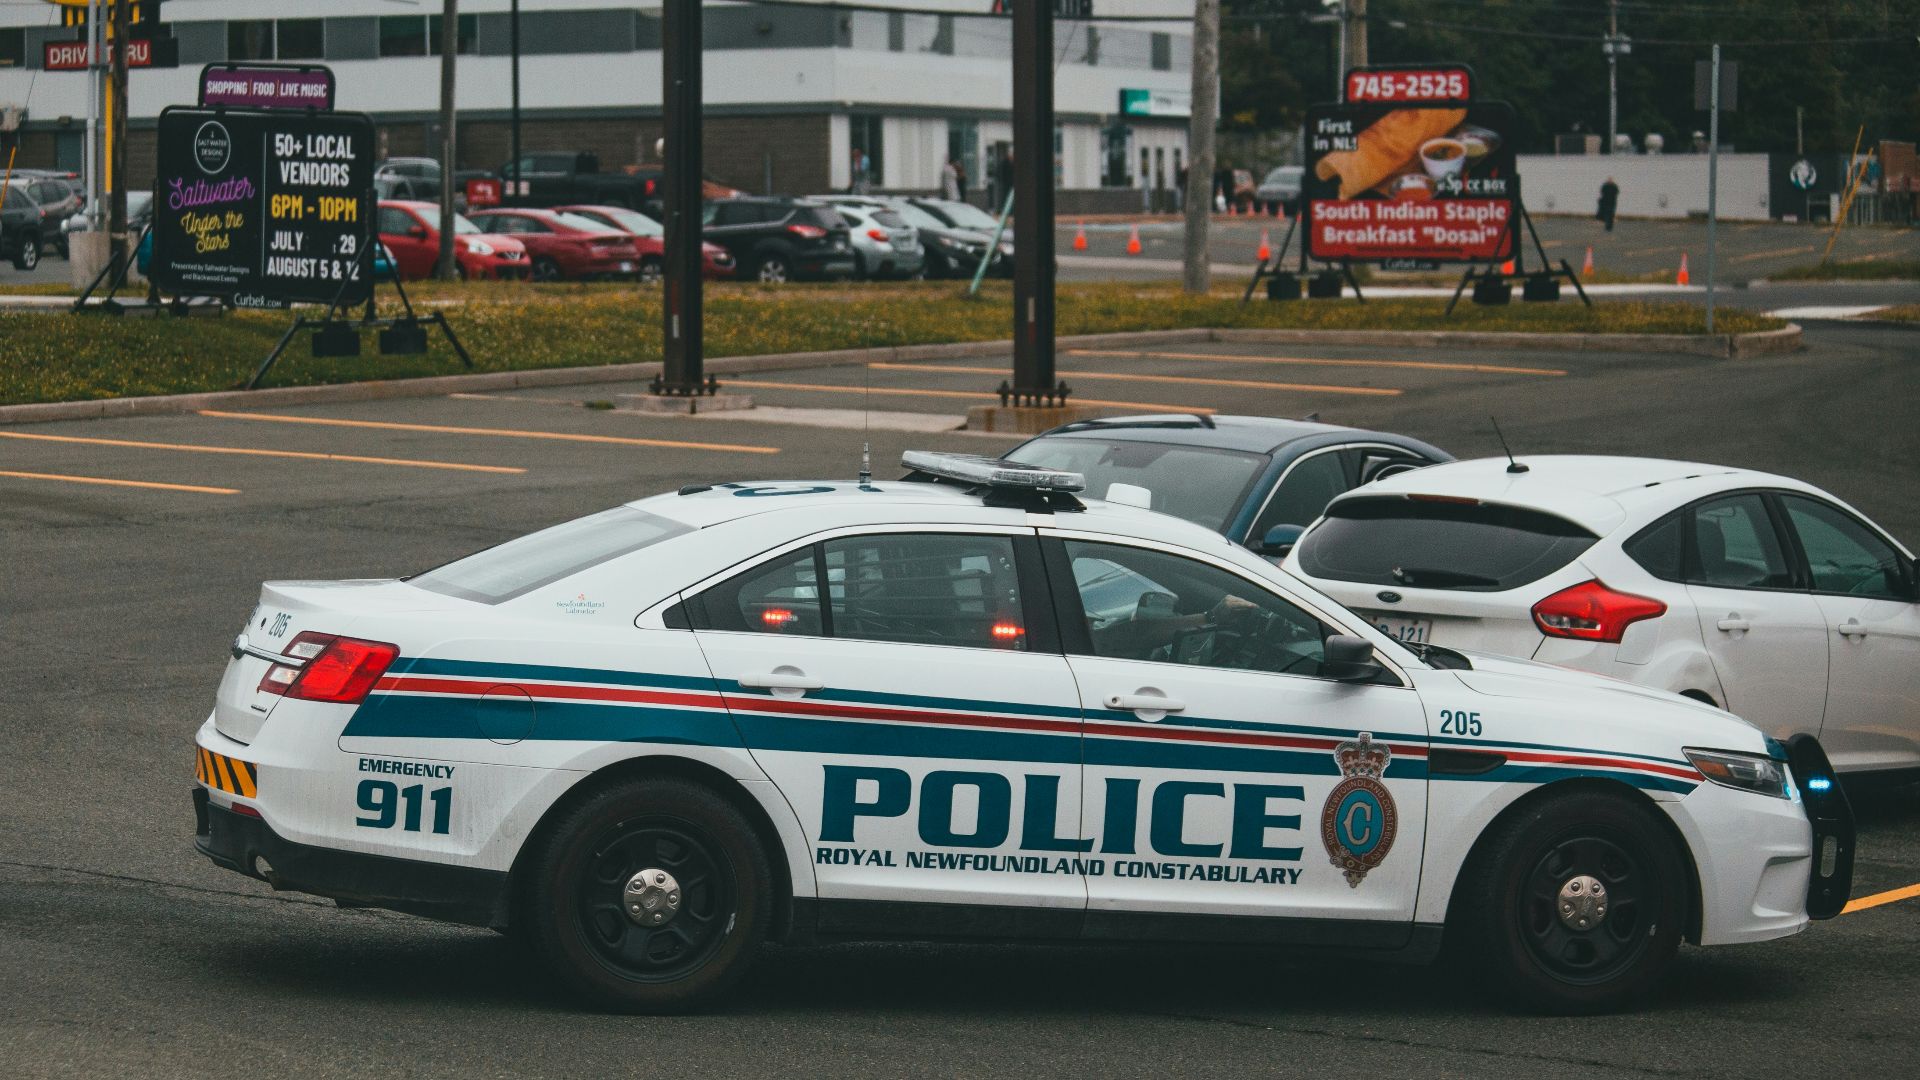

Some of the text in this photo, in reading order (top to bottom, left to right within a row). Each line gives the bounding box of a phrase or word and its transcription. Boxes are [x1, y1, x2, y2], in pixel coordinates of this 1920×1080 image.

[50, 43, 148, 64] DRIV TRU
[206, 81, 327, 97] SHOPPING FOOD LIVE MUSIC
[1354, 74, 1463, 98] 745-2525
[1319, 118, 1352, 134] First
[275, 133, 356, 159] 50+ LOCAL
[1314, 135, 1329, 150] in
[280, 161, 350, 187] VENDORS
[168, 176, 255, 210] Saltwater
[271, 194, 303, 219] 6PM
[318, 196, 357, 222] 10PM
[1314, 201, 1506, 225] South Indian Staple
[181, 210, 243, 234] Under the
[196, 232, 230, 253] Stars
[270, 230, 356, 254] JULY 29
[1323, 225, 1498, 245] Breakfast "Dosai"
[267, 256, 317, 278] AUGUST
[320, 259, 329, 279] 5
[331, 260, 342, 280] &
[268, 612, 292, 638] 205
[1440, 710, 1482, 736] 205
[359, 758, 455, 779] EMERGENCY
[356, 779, 452, 834] 911
[818, 765, 1306, 861] POLICE
[1342, 801, 1373, 846] C
[816, 847, 1303, 885] ROYAL NEWFOUNDLAND CONSTABULARY
